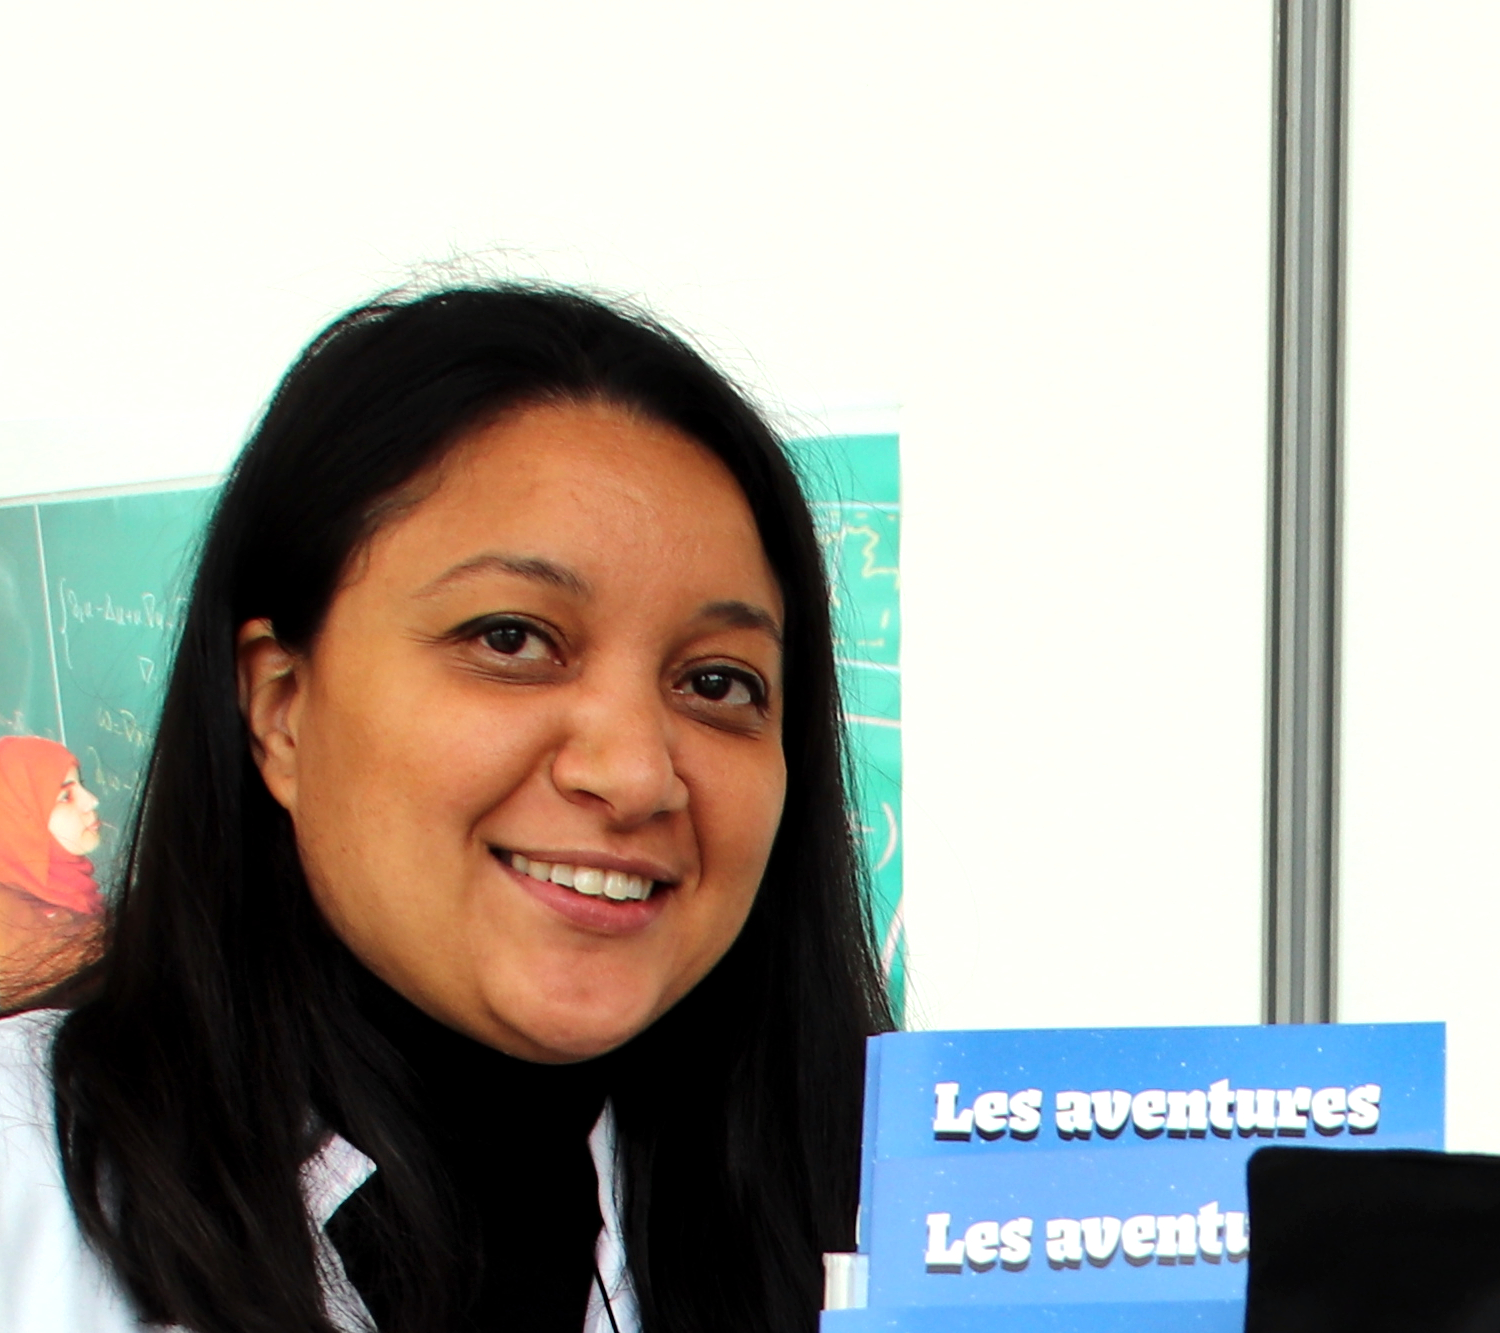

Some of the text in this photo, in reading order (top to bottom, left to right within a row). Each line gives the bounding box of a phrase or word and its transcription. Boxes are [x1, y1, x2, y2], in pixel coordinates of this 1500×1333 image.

[933, 1079, 1381, 1141] Les aventures
[925, 1202, 1249, 1273] Les aventu
